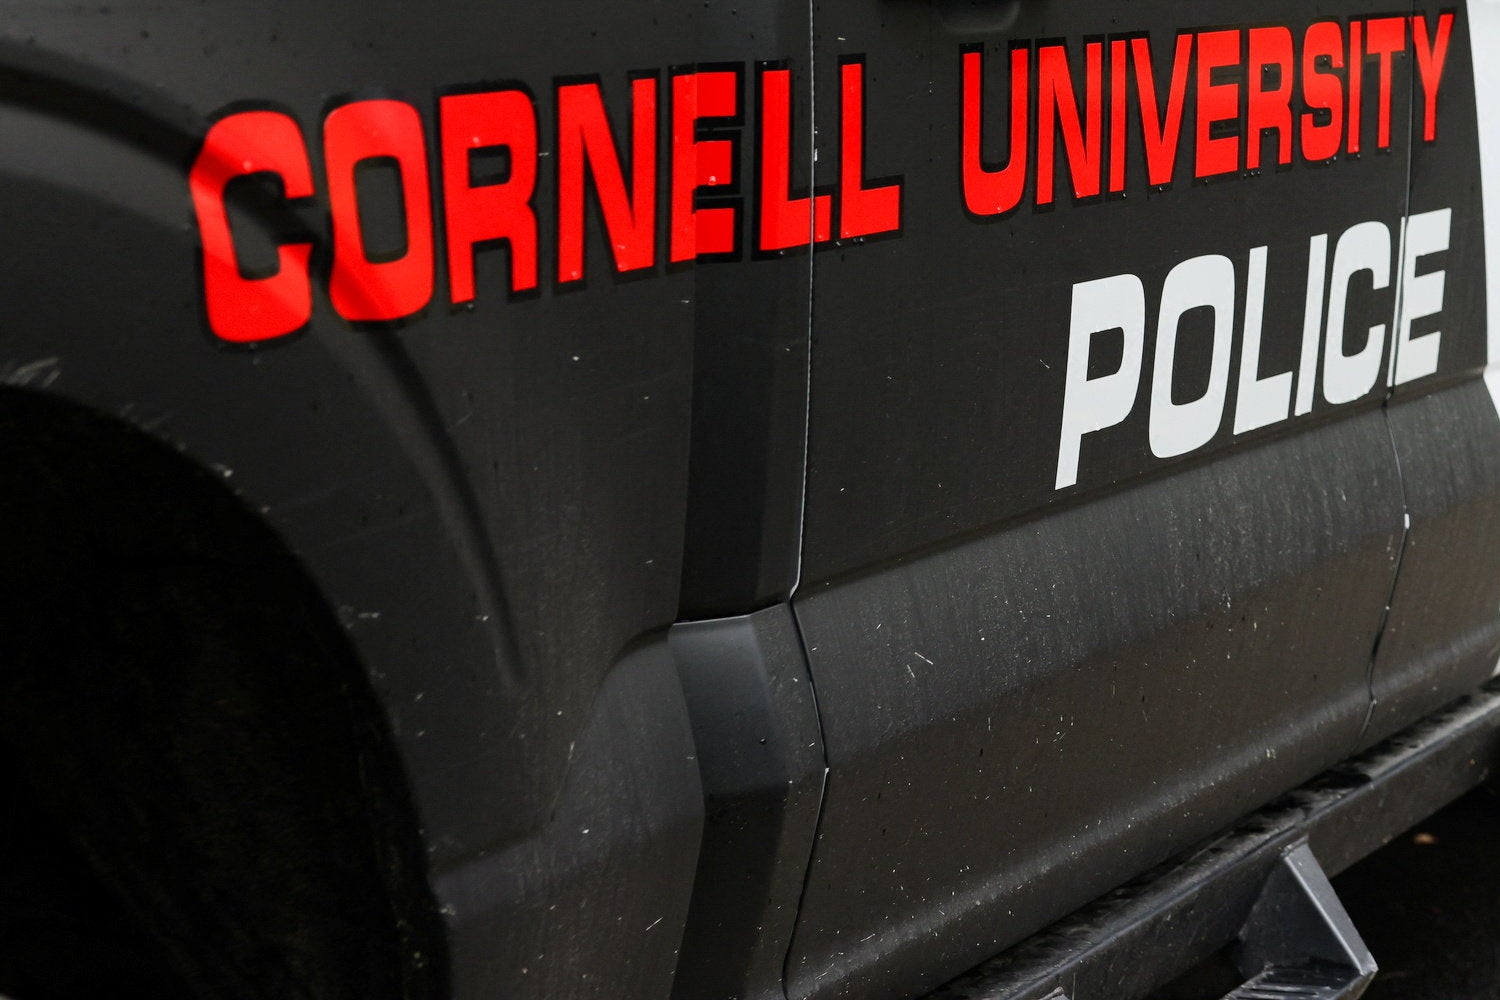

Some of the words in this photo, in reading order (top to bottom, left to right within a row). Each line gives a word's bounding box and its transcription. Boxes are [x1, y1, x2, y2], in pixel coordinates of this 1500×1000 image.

[188, 63, 901, 343] CORNELL
[962, 13, 1455, 216] UNIVERSITY
[1055, 207, 1452, 490] POLICE
